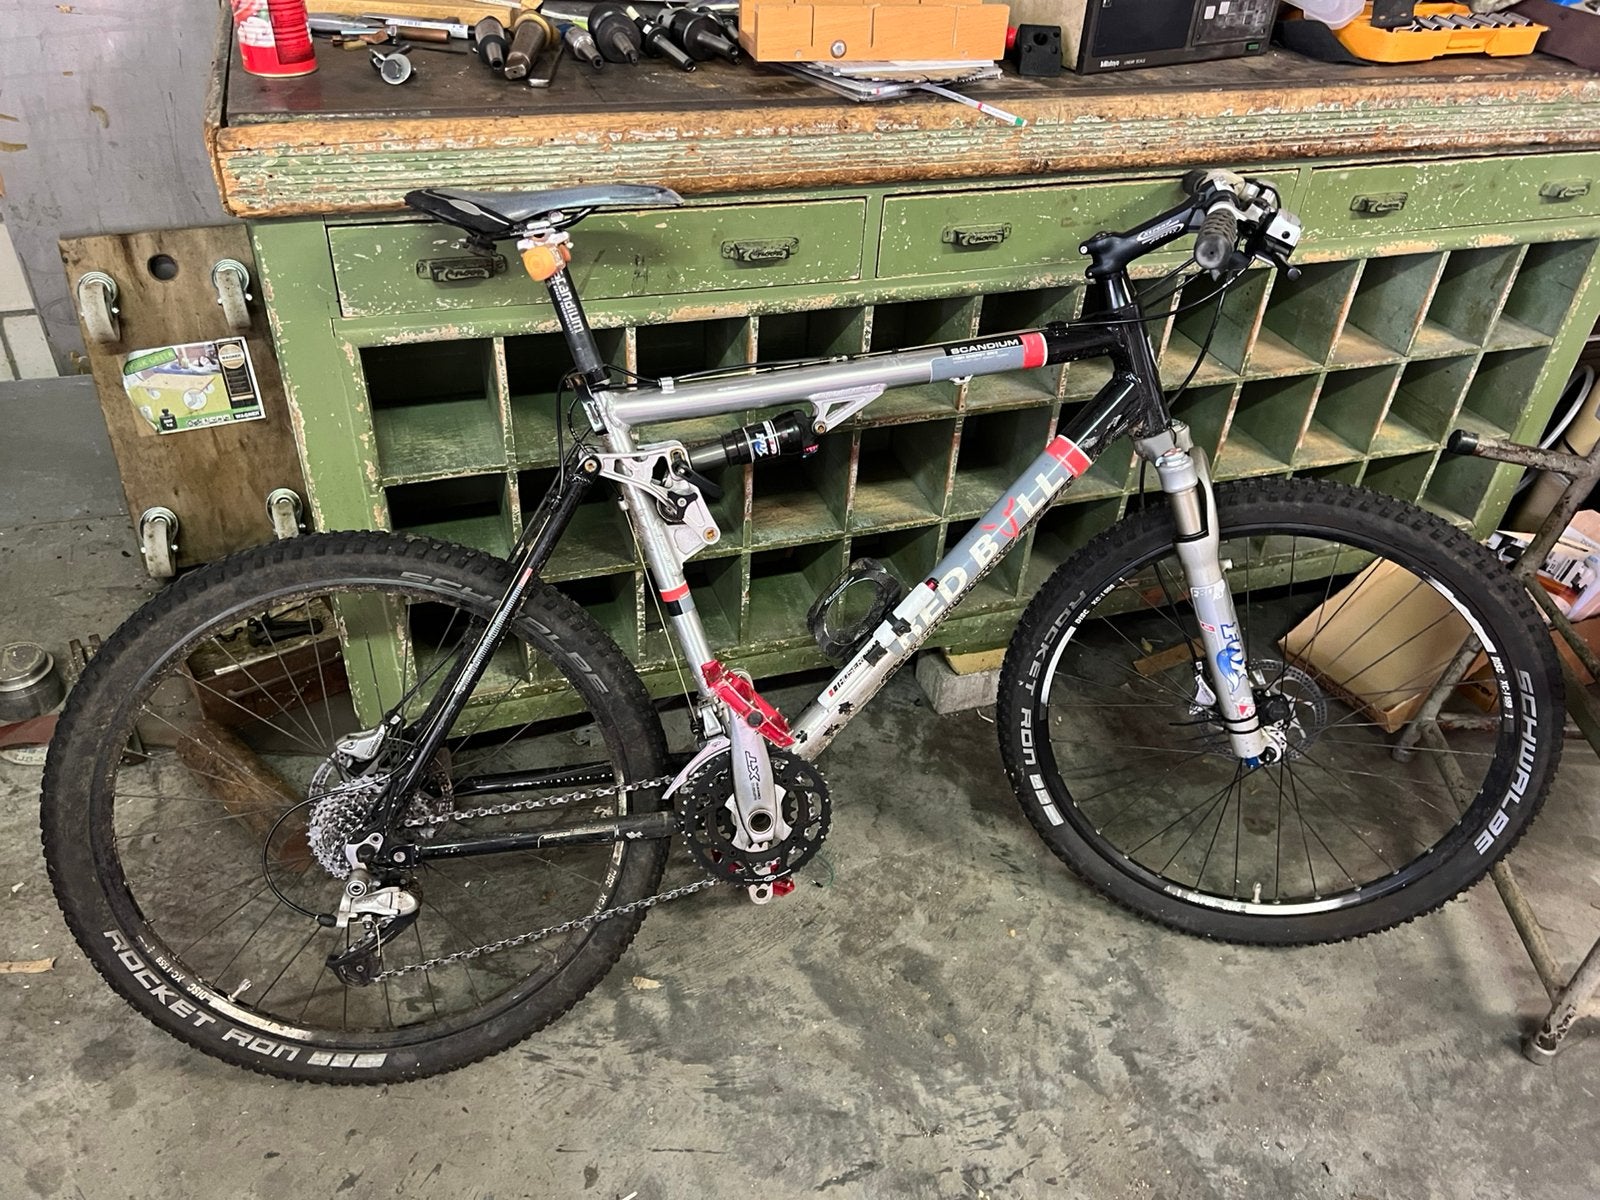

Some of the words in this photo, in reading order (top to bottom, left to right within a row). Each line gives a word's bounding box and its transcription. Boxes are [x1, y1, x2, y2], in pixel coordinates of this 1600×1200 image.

[951, 339, 1019, 354] SCANDIUM
[235, 410, 260, 420] WAGNER
[1074, 608, 1090, 624] DISC
[1025, 590, 1086, 697] ROCKET
[1020, 707, 1037, 766] RON
[744, 750, 761, 782] XT
[1473, 669, 1538, 856] SCHWALBE
[103, 930, 216, 1028] ROCKET
[186, 983, 209, 1001] DISC
[221, 1028, 301, 1063] RON
